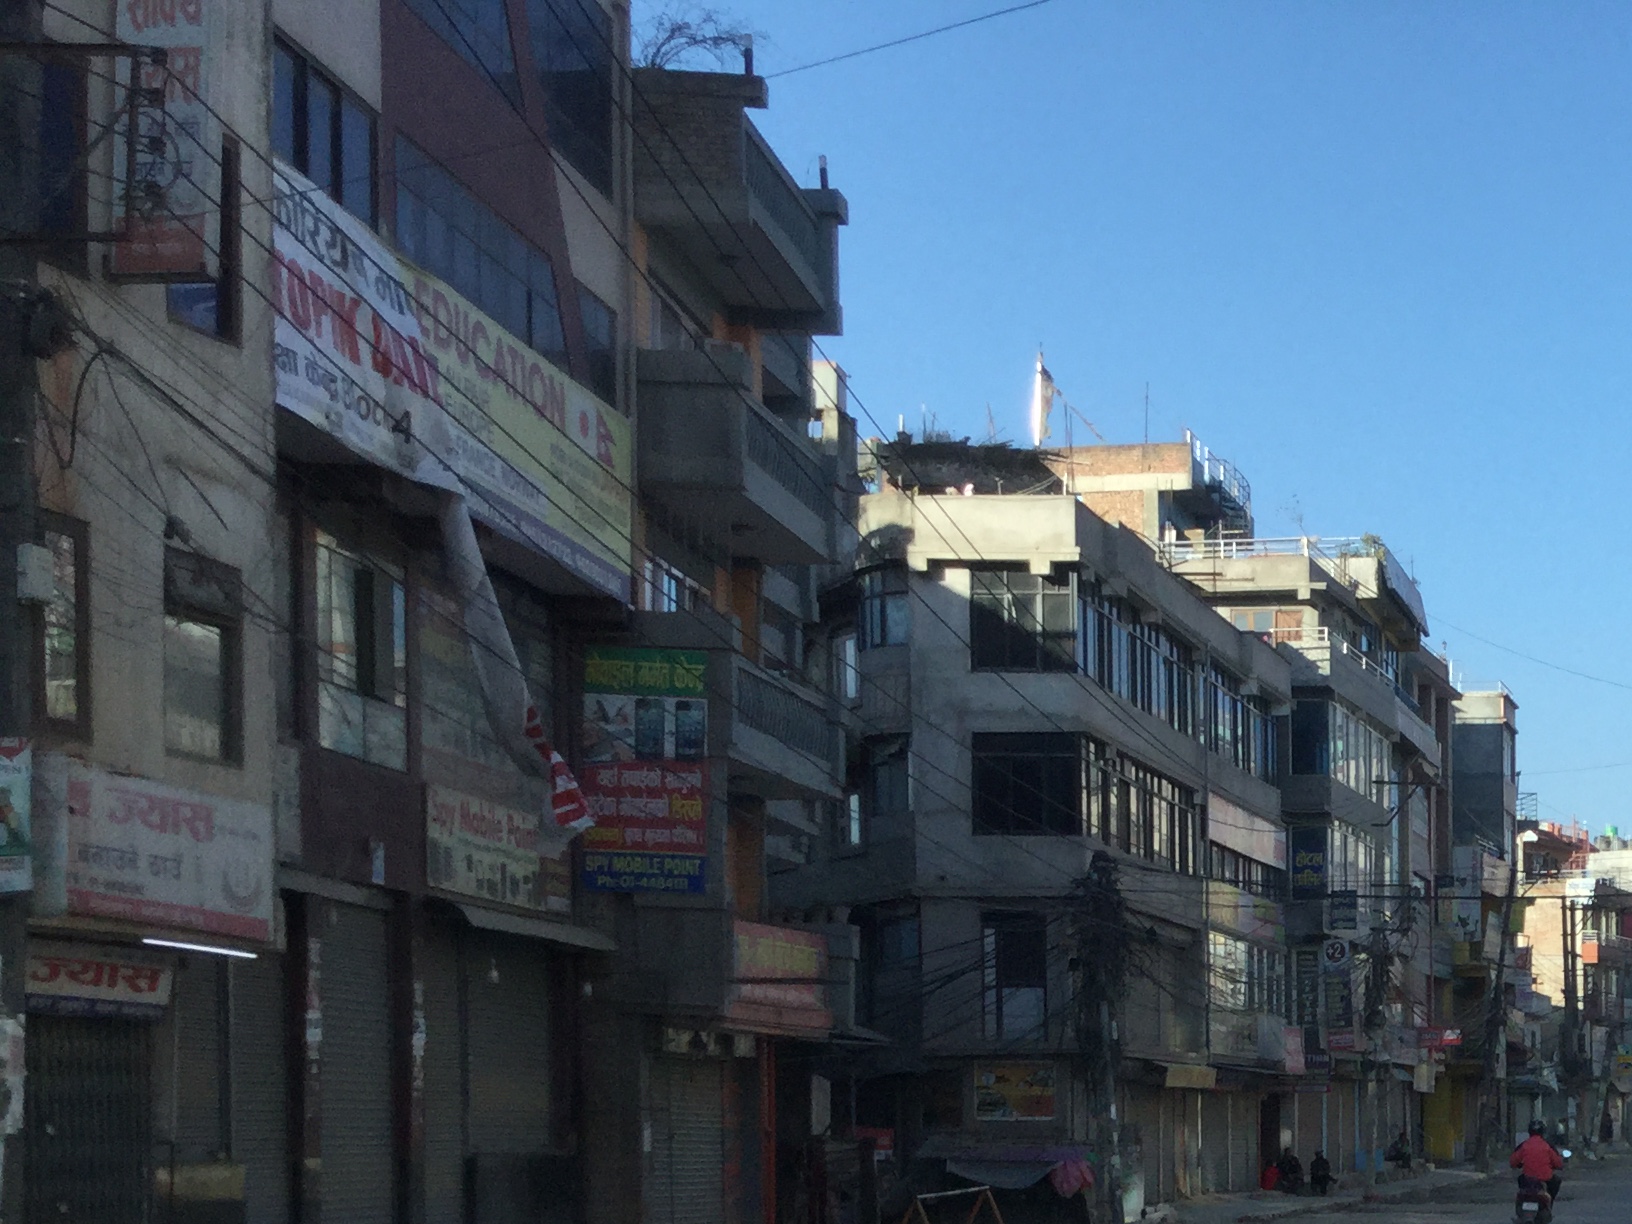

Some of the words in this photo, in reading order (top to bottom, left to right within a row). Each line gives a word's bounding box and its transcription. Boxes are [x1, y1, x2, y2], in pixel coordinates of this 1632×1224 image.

[413, 277, 566, 432] EDUCATION
[585, 855, 609, 872] SPY
[611, 856, 661, 874] MOBILE
[664, 857, 701, 876] POINT
